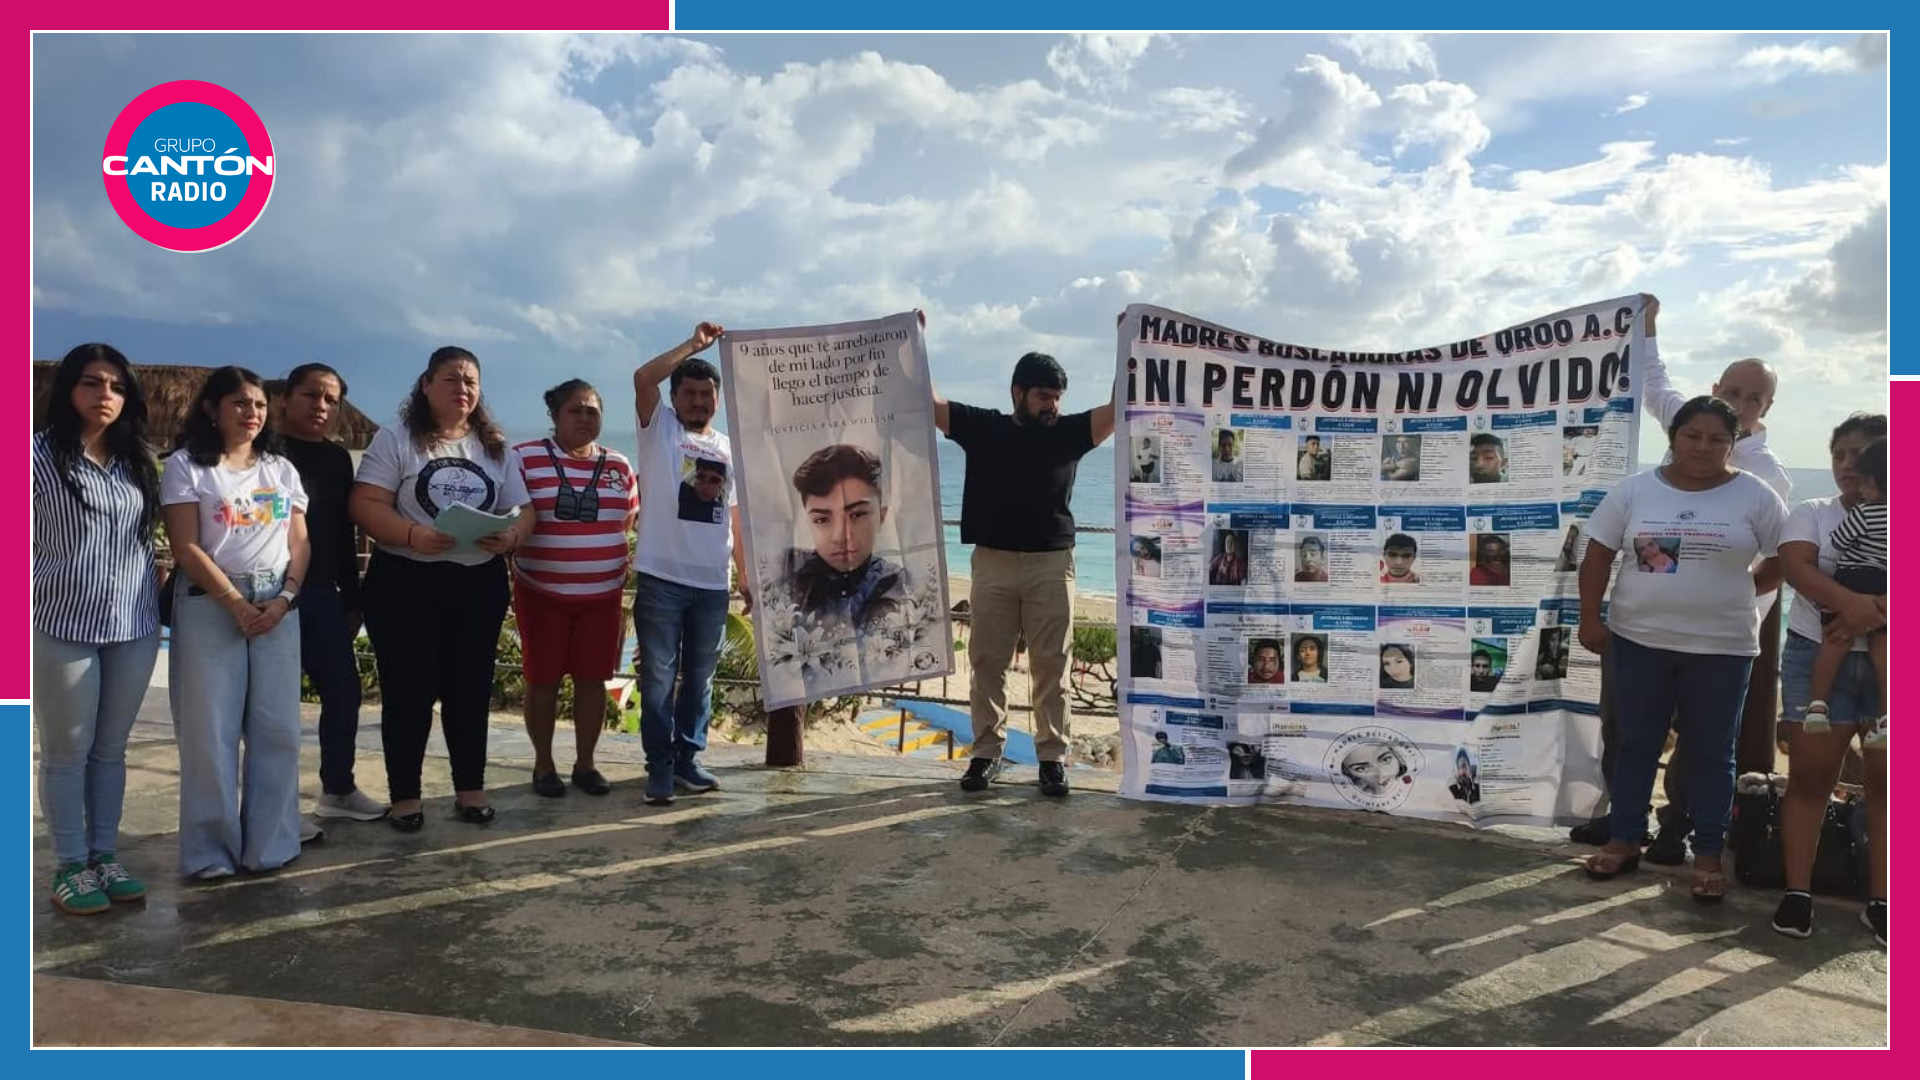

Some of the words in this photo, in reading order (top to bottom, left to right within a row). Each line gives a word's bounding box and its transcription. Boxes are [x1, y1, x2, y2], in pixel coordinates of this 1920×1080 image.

[739, 343, 749, 356] 9
[752, 342, 785, 357] años
[788, 342, 814, 358] que
[817, 339, 830, 351] te
[833, 328, 908, 351] arrebataron
[1139, 314, 1251, 353] MADRES
[1450, 338, 1489, 360] DE
[1495, 319, 1574, 357] QROO
[768, 359, 786, 373] de
[789, 357, 808, 372] mi
[811, 355, 841, 371] lado
[844, 353, 865, 369] por
[868, 347, 886, 361] fin
[772, 375, 806, 393] llego
[809, 373, 821, 387] el
[824, 366, 870, 386] tiempo
[873, 364, 890, 378] de
[1127, 356, 1187, 407] ¡NI
[1202, 361, 1380, 413] PERDÓN
[1394, 372, 1443, 414] NI
[1456, 344, 1631, 411] OLVIDO!
[791, 390, 830, 407] hacer
[830, 382, 883, 405] justicia.
